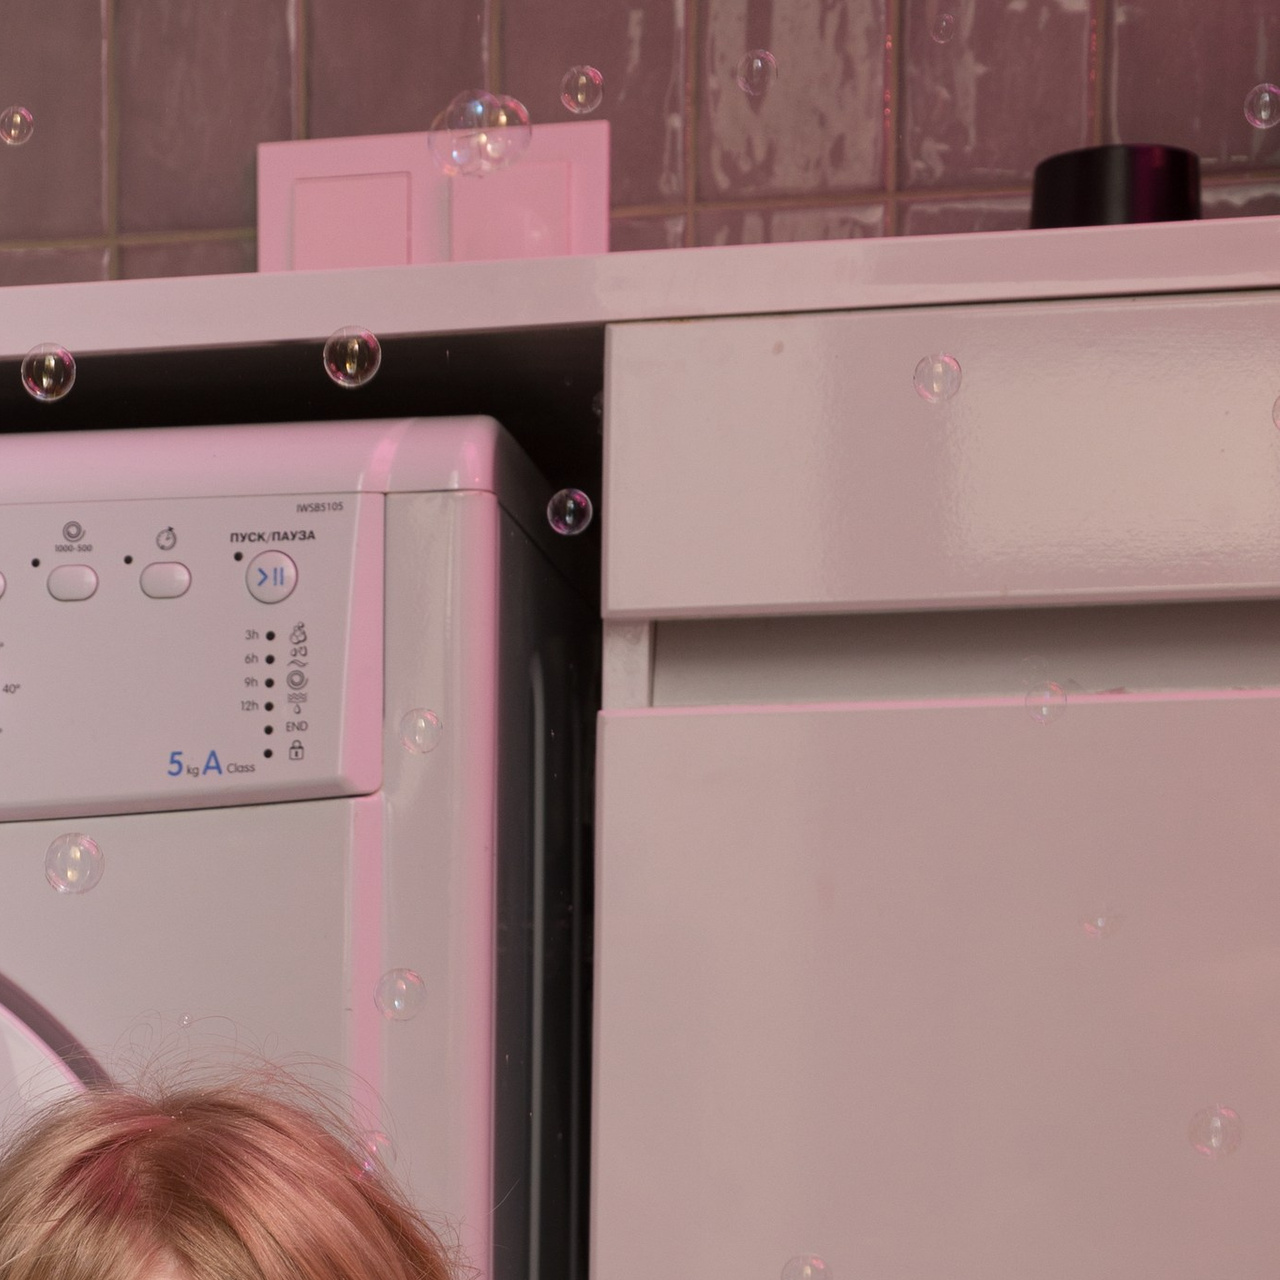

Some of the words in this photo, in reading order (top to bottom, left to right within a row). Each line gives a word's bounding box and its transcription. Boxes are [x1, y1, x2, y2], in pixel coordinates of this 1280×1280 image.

[229, 530, 316, 544] ПУСК/ПАУЗА
[245, 630, 259, 640] 3h
[244, 654, 258, 664] 6h
[244, 677, 258, 688] 9h
[240, 701, 259, 711] 12h
[286, 721, 308, 732] END
[167, 751, 183, 776] 5
[187, 764, 199, 777] kg
[202, 749, 223, 775] A
[227, 763, 255, 774] Class
